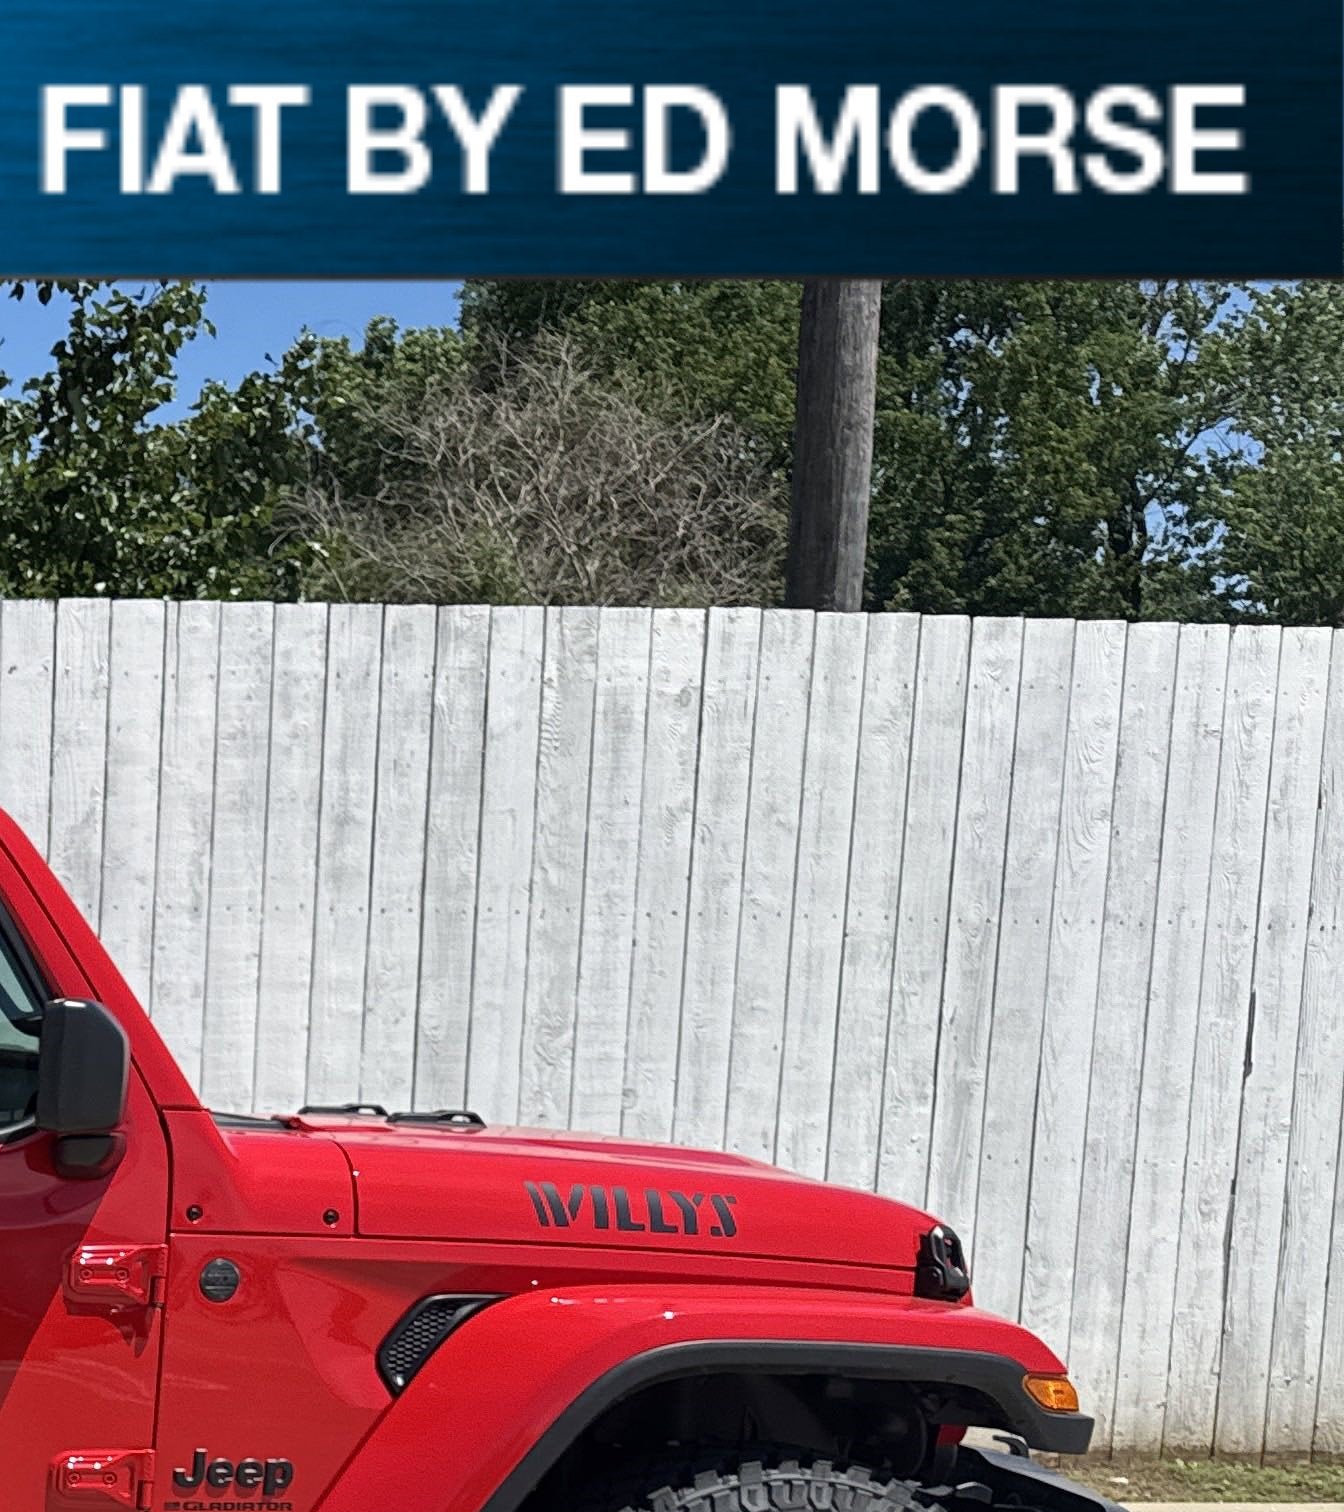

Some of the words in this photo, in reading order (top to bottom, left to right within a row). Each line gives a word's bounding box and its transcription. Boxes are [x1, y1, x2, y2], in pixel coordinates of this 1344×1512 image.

[524, 1181, 737, 1237] WILLYS
[172, 1448, 294, 1496] Jeep
[182, 1501, 293, 1512] GLADIATOR
